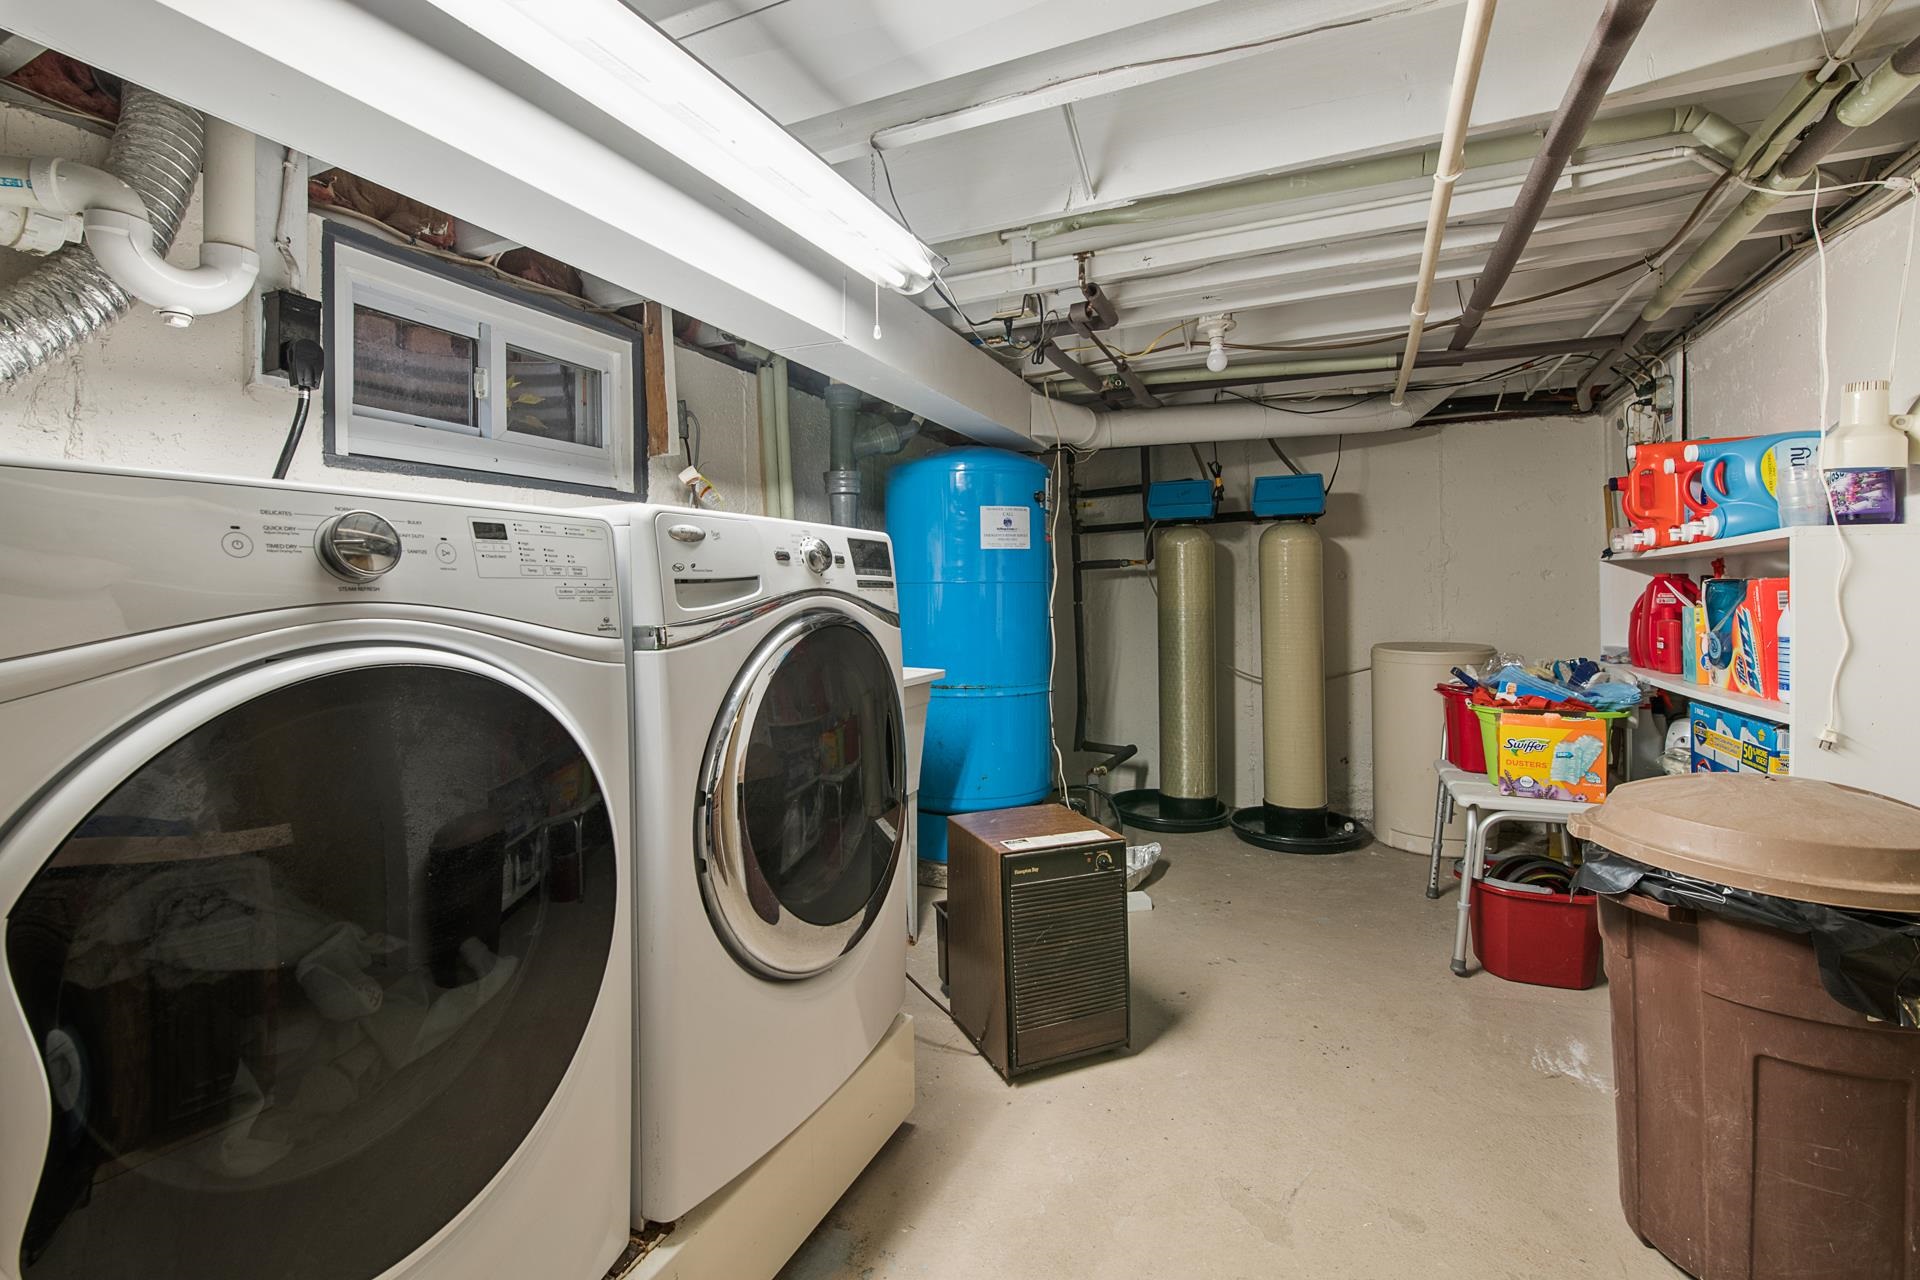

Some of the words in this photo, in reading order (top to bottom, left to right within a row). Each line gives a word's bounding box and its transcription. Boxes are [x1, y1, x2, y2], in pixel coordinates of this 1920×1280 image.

[1737, 609, 1761, 695] BUZZ
[1736, 654, 1748, 685] Tide
[1504, 739, 1547, 752] Swiffer
[1505, 759, 1548, 769] DUSTERS
